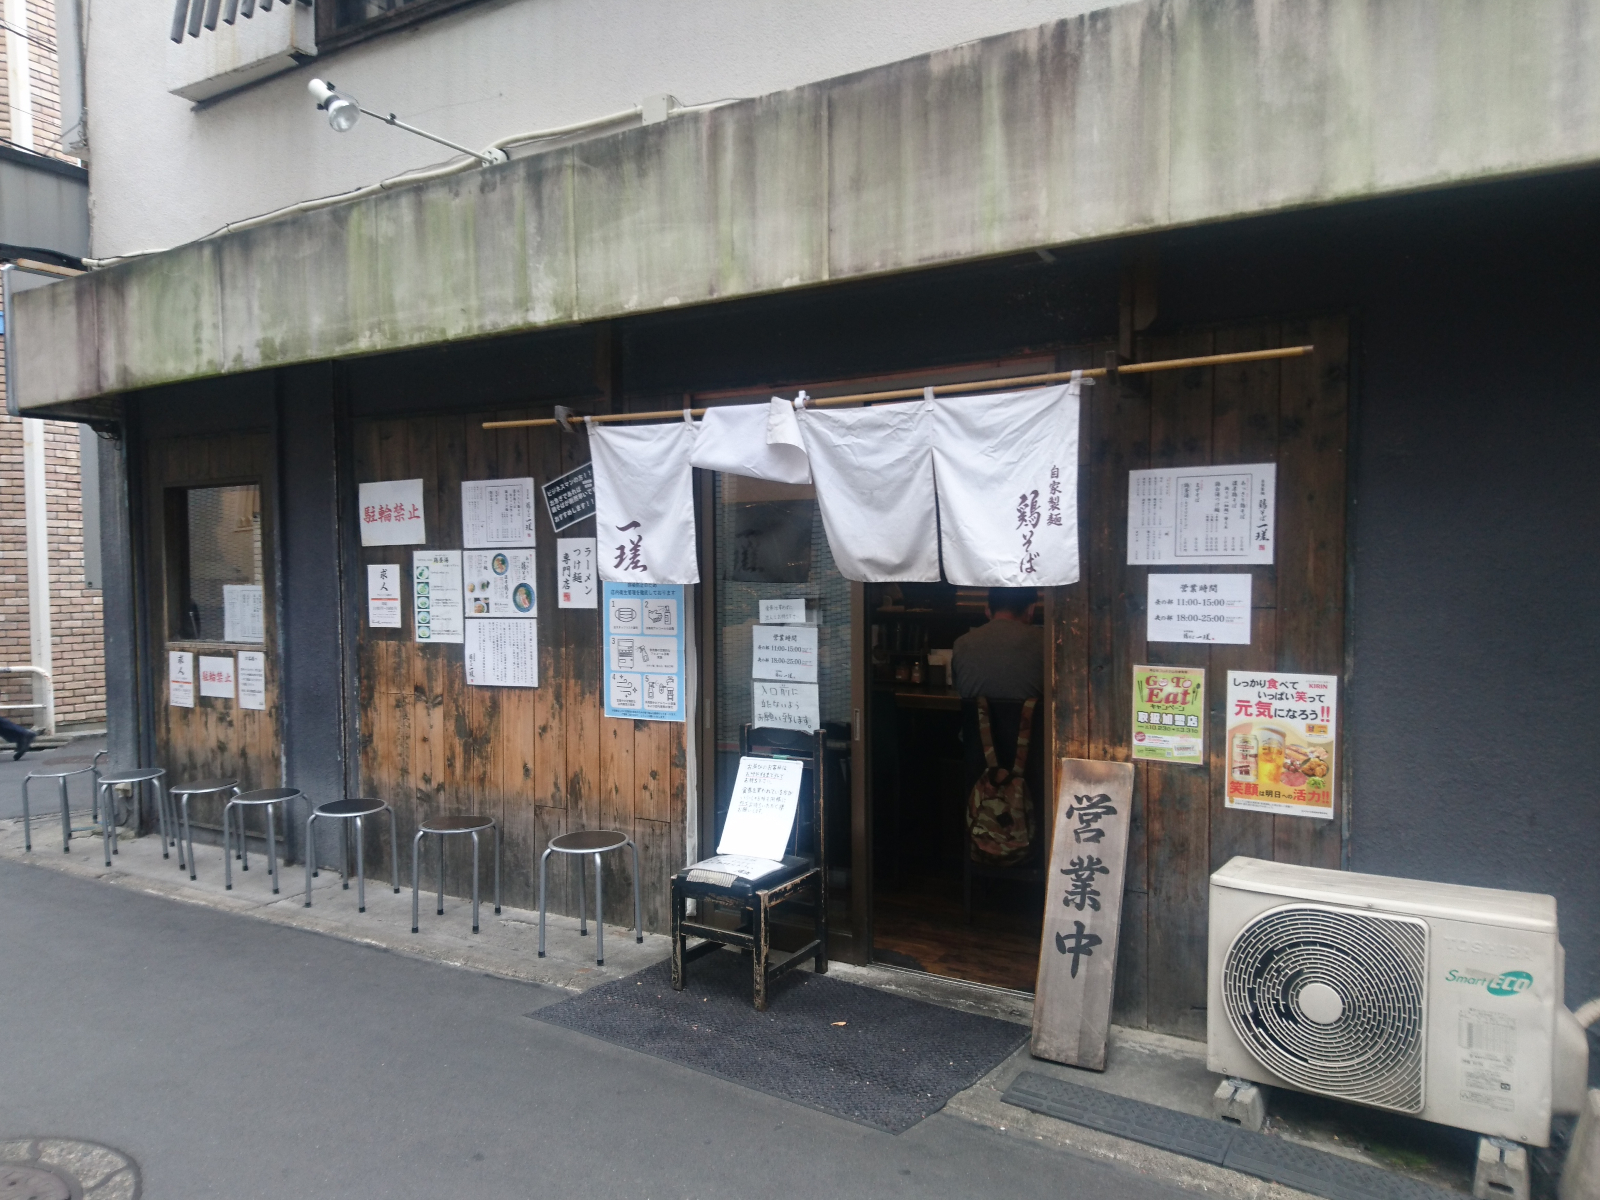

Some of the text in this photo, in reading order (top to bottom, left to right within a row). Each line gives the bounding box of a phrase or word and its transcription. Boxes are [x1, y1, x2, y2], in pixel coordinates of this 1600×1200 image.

[1046, 465, 1063, 526] 自家製麺
[363, 502, 421, 524] 駐輪禁止
[1015, 489, 1042, 574] 鶏そば
[613, 520, 648, 573] 一瑳
[562, 553, 571, 590] 専門店
[572, 548, 583, 583] つけ麺
[584, 547, 593, 595] ラーメン
[380, 568, 389, 592] 求人
[1180, 583, 1218, 594] 営業時間
[1176, 598, 1225, 607] 11:00-15:00
[1176, 614, 1225, 623] 18:00-25:00
[773, 633, 798, 642] 営業時間
[202, 670, 233, 683] 駐輪禁止
[1233, 678, 1299, 690] しっかり食べて
[761, 683, 799, 697] 入口前に
[1145, 687, 1190, 706] Eat
[1257, 691, 1325, 703] いっぱい笑って
[1150, 703, 1185, 712] キャンペーン
[1055, 792, 1118, 979] 営業中
[1445, 968, 1488, 988] Smart
